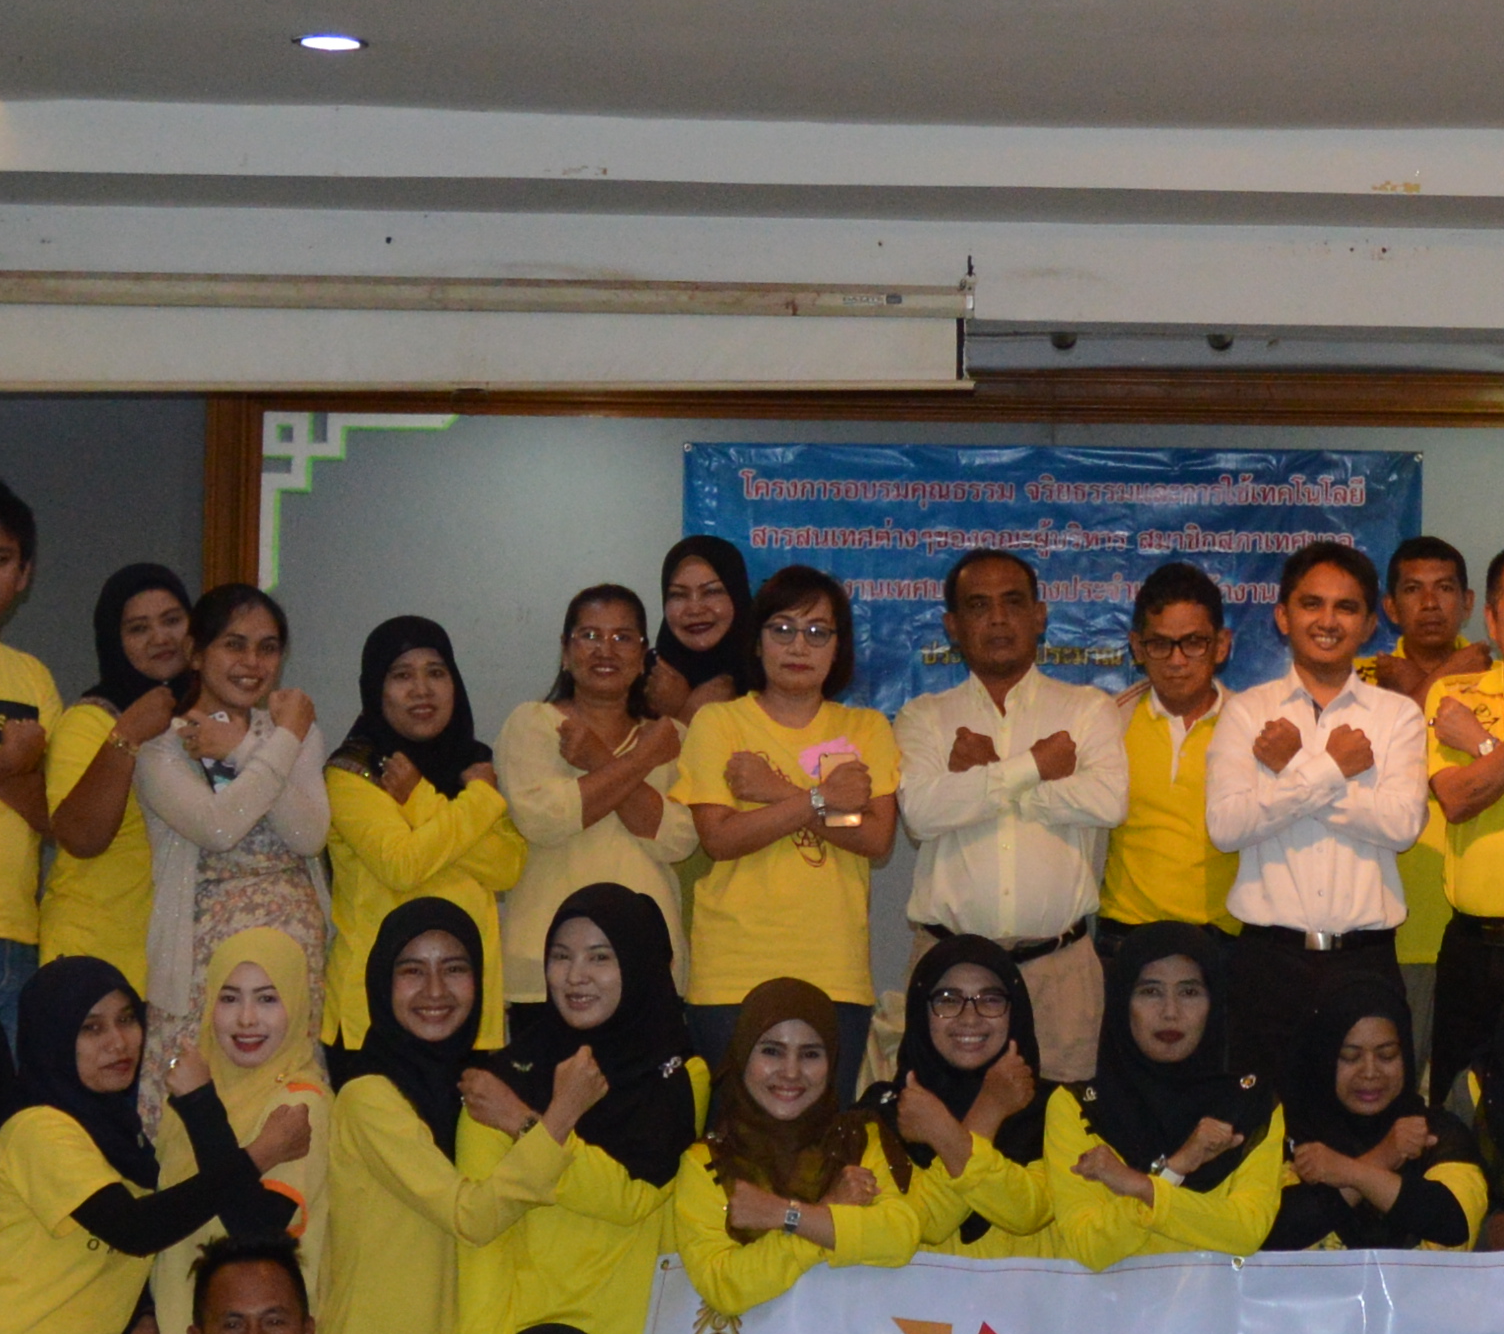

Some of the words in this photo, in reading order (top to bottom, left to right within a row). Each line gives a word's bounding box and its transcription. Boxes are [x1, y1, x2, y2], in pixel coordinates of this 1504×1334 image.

[739, 469, 1014, 509] โครงการอบรมคุณธรรม
[1027, 473, 1366, 507] จริยธรรมและการใช้เทคโนโลยี
